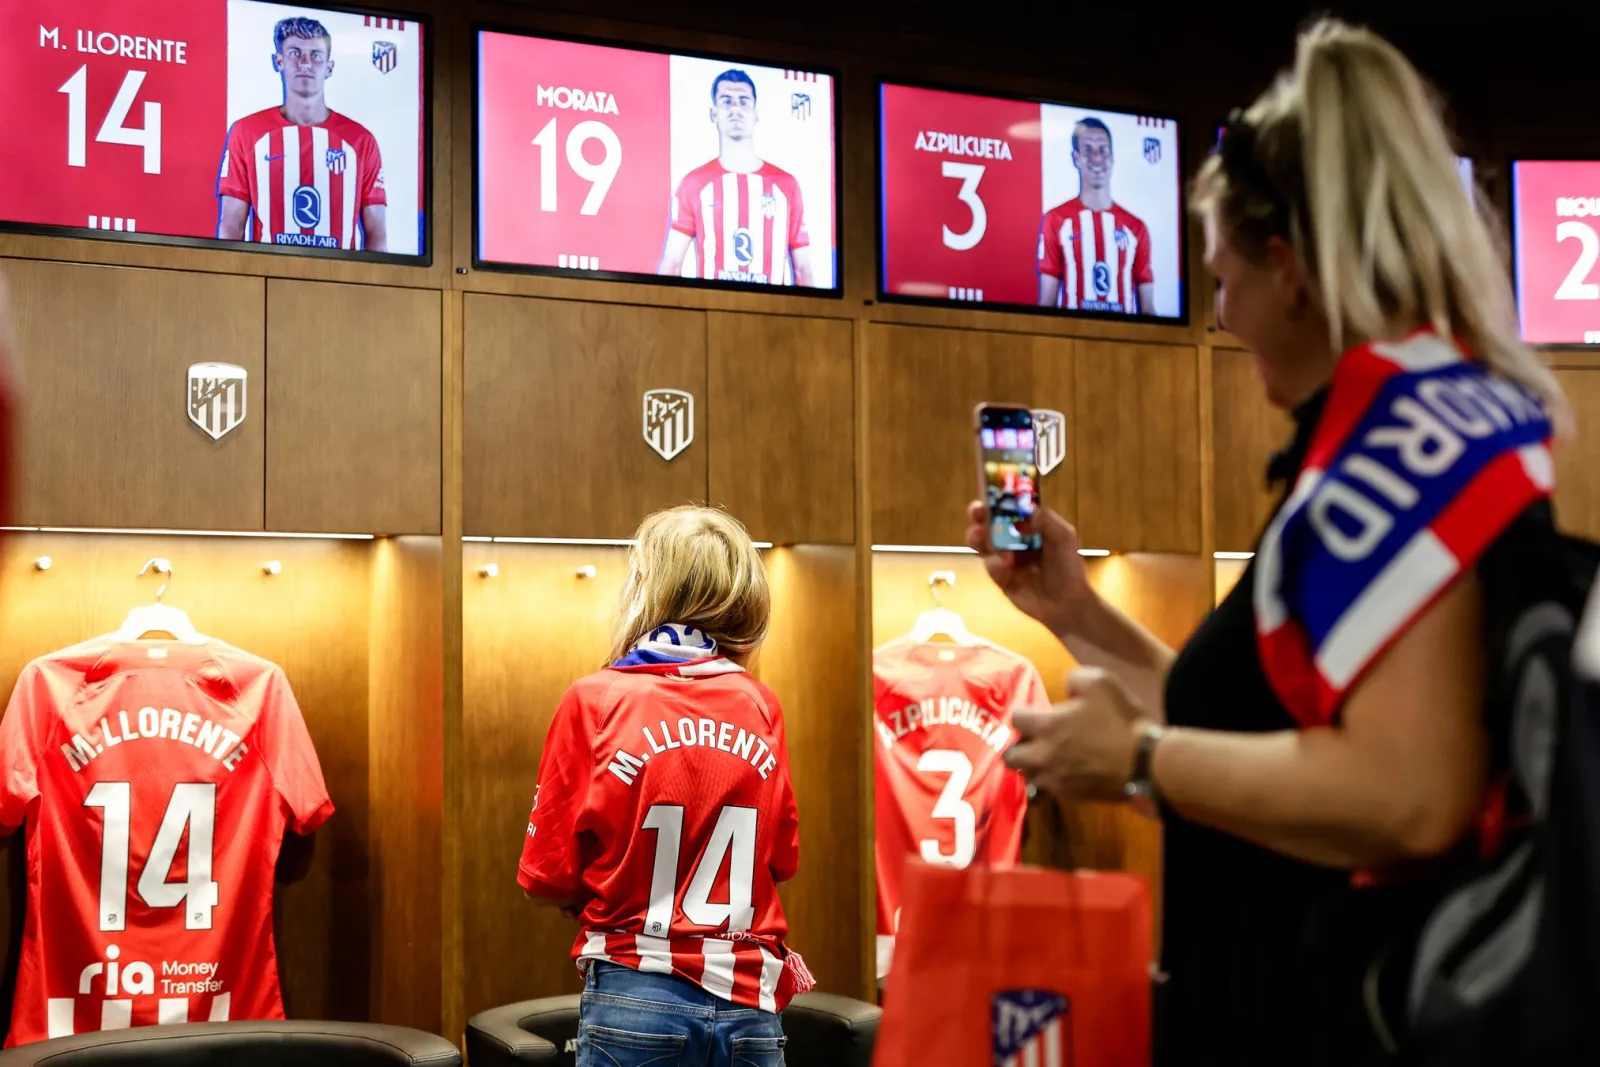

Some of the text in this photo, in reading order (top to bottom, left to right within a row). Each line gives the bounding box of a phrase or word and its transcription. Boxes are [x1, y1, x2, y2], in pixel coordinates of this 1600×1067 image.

[39, 24, 188, 65] M. LLORENTE
[57, 63, 162, 175] 14
[536, 84, 620, 115] MORATA
[531, 117, 622, 216] 19
[914, 131, 1013, 161] AZPILICUETA
[941, 161, 988, 251] 3
[276, 233, 338, 248] RIYADH AIR
[1553, 220, 1600, 300] 2
[877, 696, 1012, 752] AZPILICUETA
[916, 749, 977, 871] 3
[82, 781, 219, 932] 14
[641, 804, 759, 939] 14
[78, 943, 155, 996] ria
[161, 960, 219, 978] Money
[161, 977, 224, 995] Transfer
